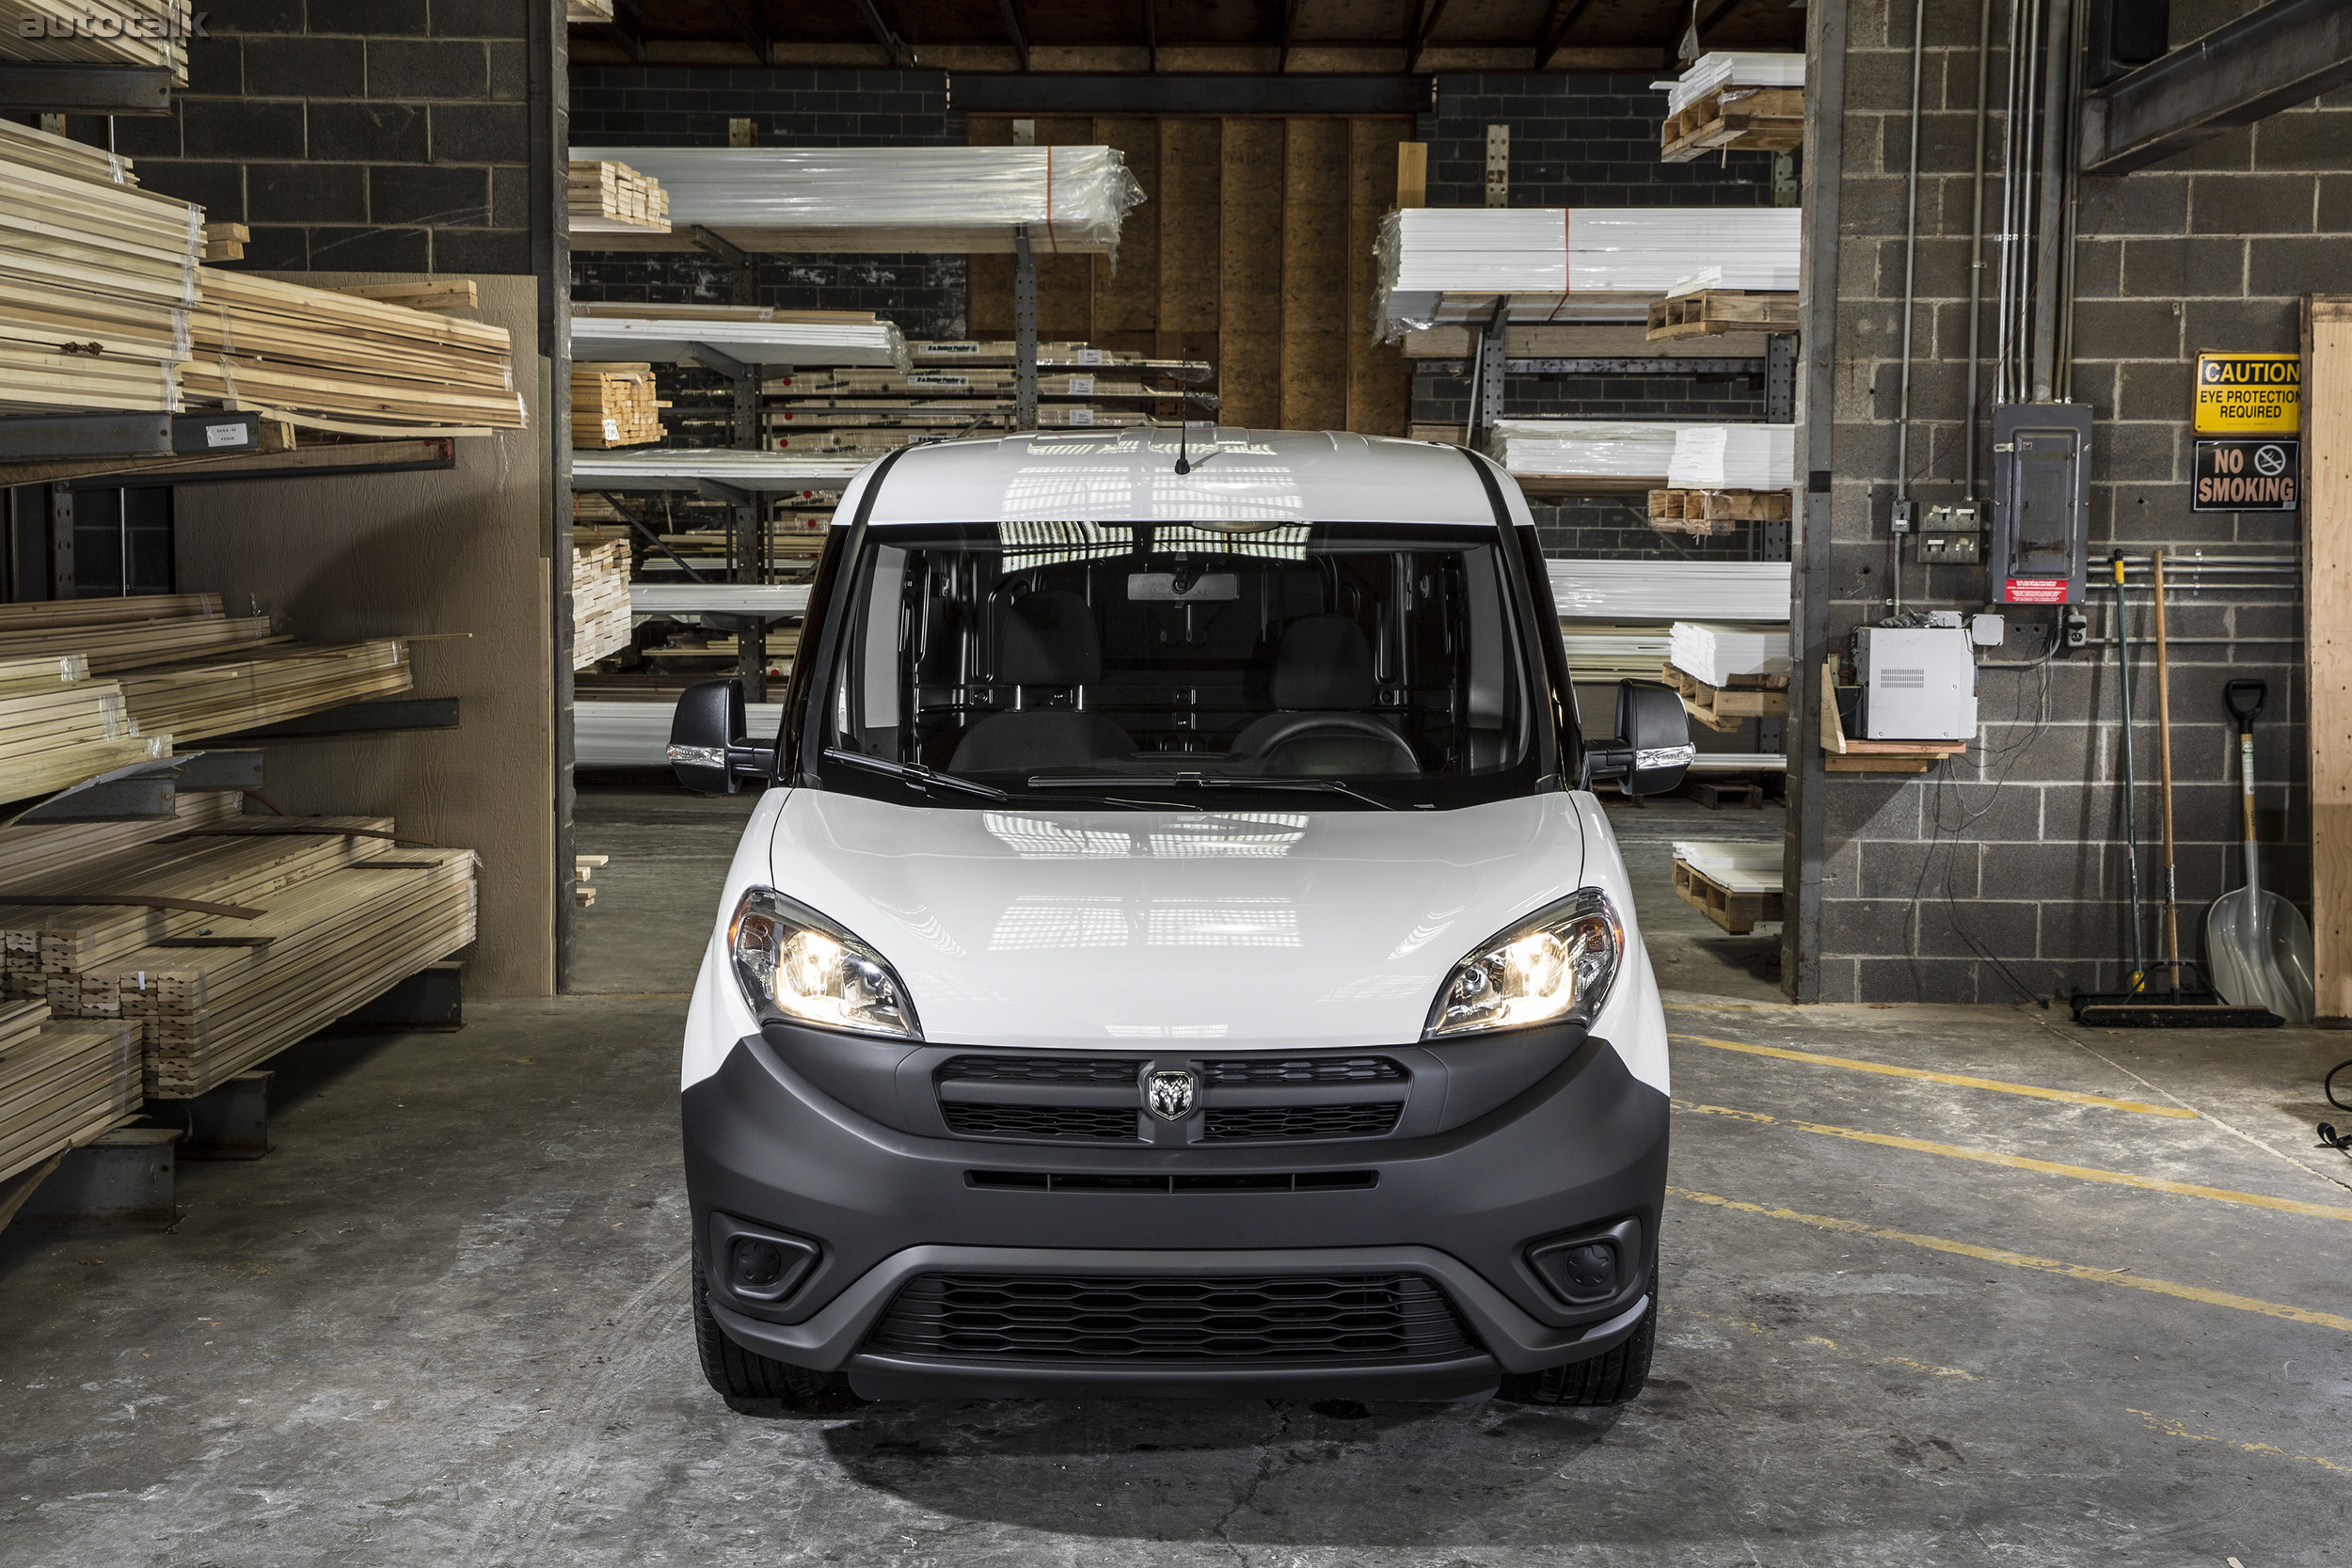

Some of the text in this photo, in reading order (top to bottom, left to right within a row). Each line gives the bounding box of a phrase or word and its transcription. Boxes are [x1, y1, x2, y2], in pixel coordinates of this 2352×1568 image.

[2204, 362, 2300, 383] CAUTION
[2201, 390, 2301, 403] EYE PROTECTION
[2220, 405, 2281, 418] REQUIRED
[2215, 449, 2244, 474] NO
[2199, 477, 2295, 502] SMOKING
